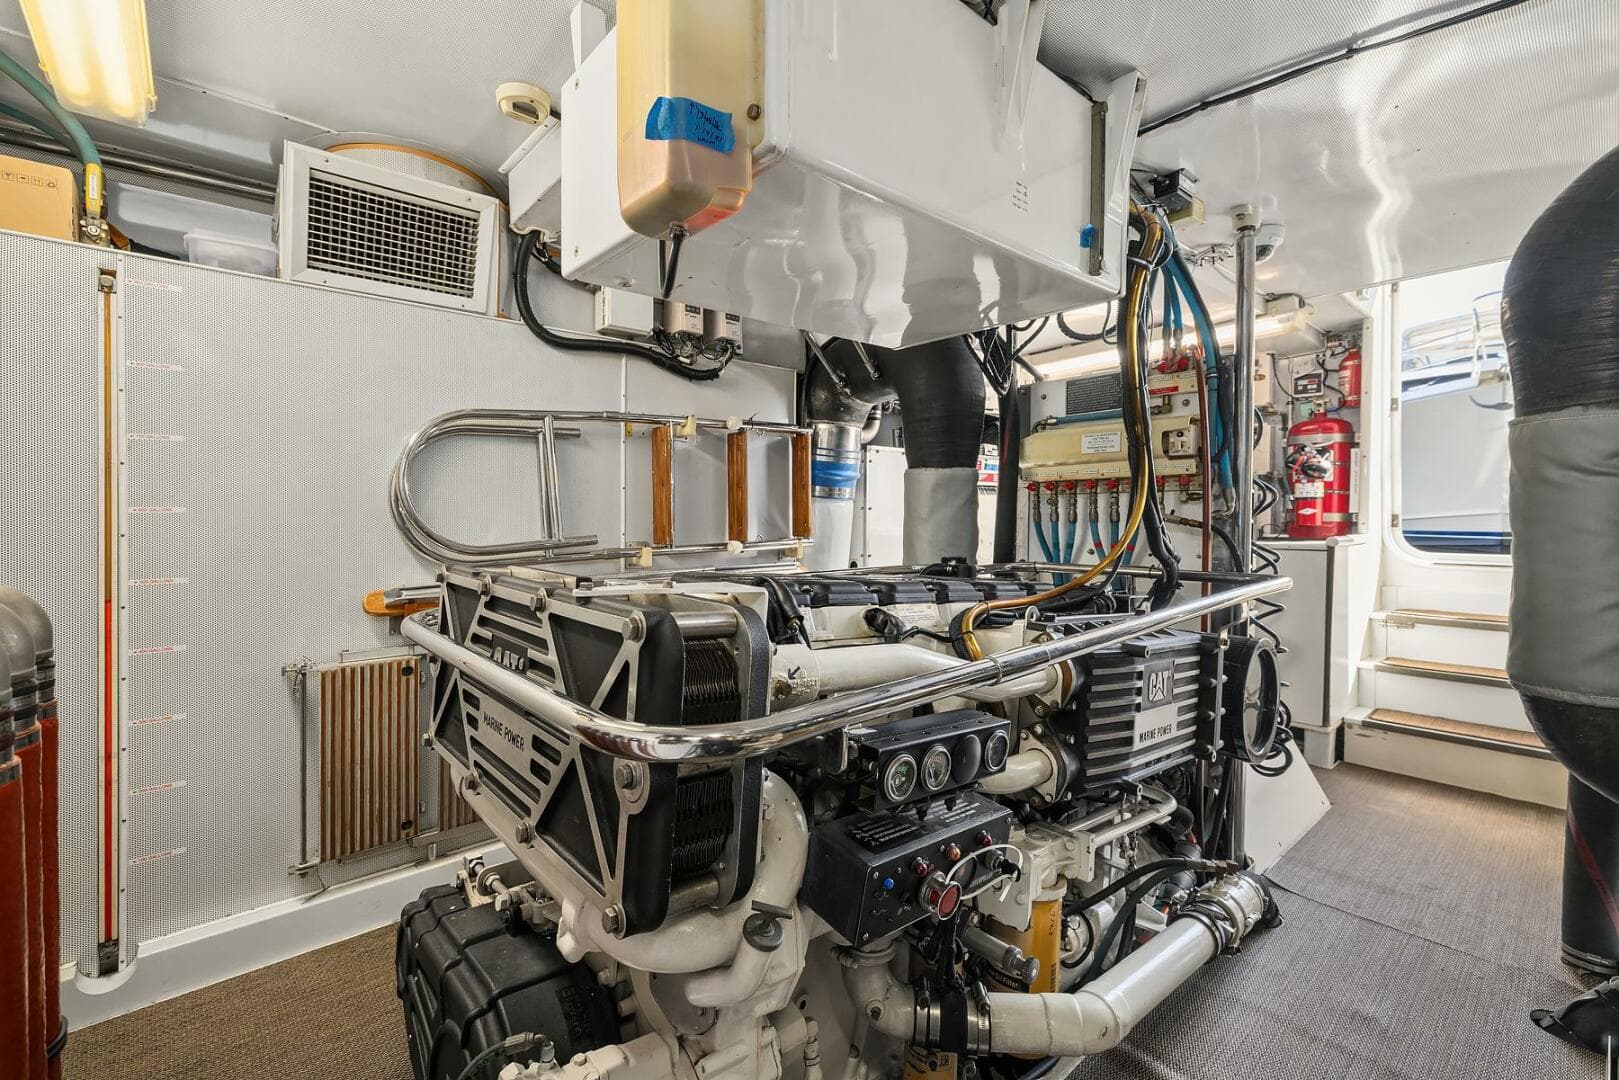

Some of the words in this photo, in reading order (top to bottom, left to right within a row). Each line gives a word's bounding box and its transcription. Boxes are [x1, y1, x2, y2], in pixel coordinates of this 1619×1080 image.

[1149, 671, 1169, 701] CAT
[483, 711, 504, 737] MARINE
[504, 726, 525, 752] POWER
[1139, 728, 1156, 743] MARINE
[1157, 724, 1172, 738] POWER
